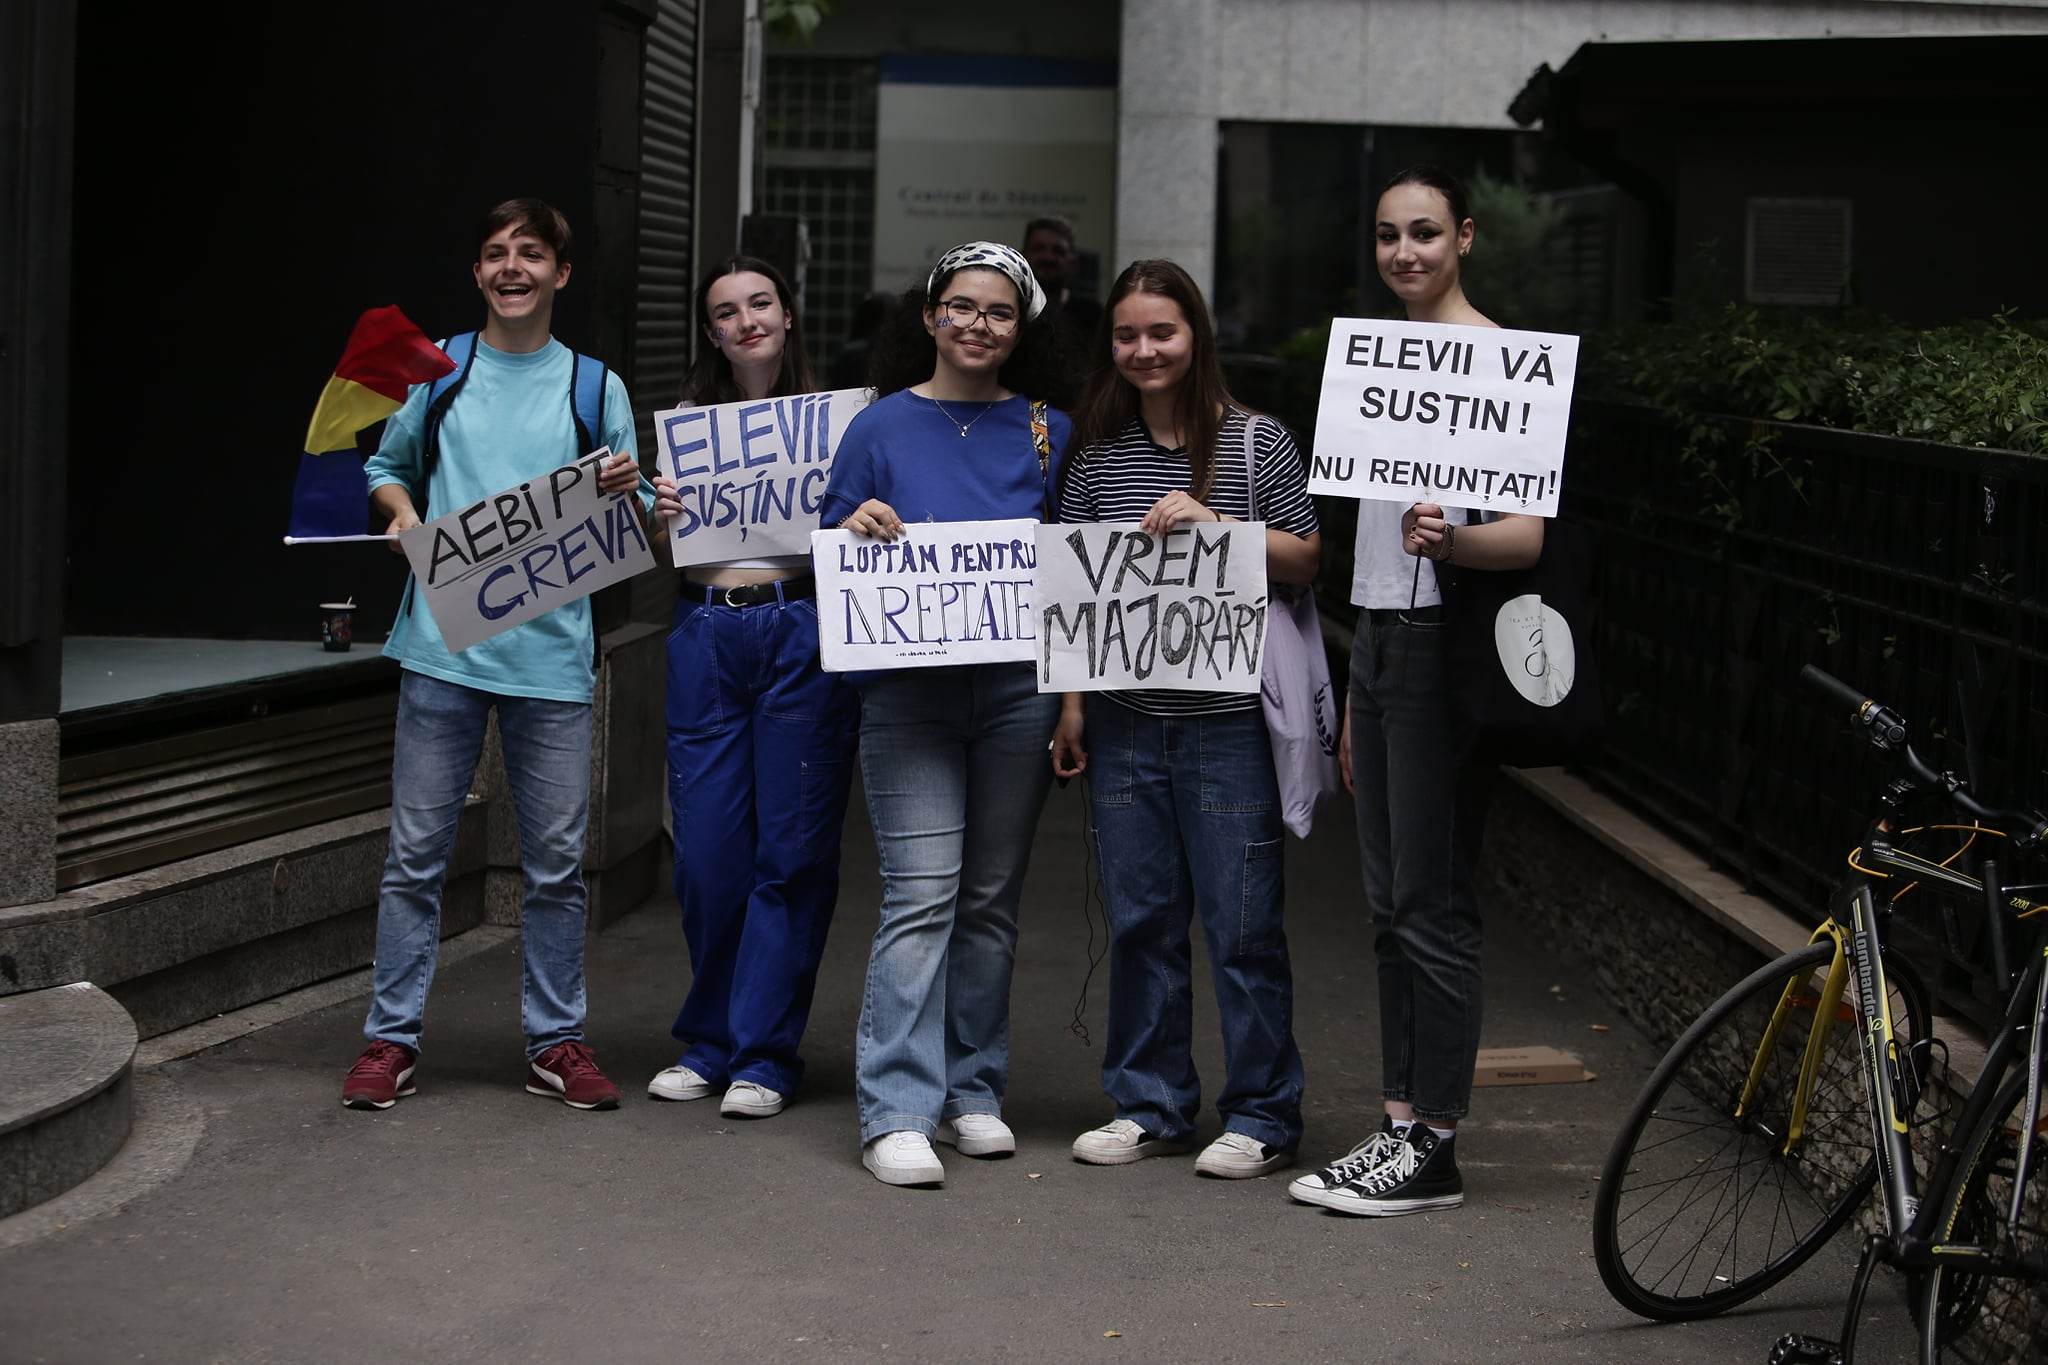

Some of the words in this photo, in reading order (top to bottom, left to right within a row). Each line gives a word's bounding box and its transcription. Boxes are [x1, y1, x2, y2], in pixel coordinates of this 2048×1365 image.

[1345, 334, 1474, 376] ELEVII
[1501, 344, 1555, 386] VĂ
[800, 467, 832, 516] G
[1311, 455, 1355, 482] NU
[950, 538, 1037, 573] PENTRU
[1065, 527, 1232, 595] VREM
